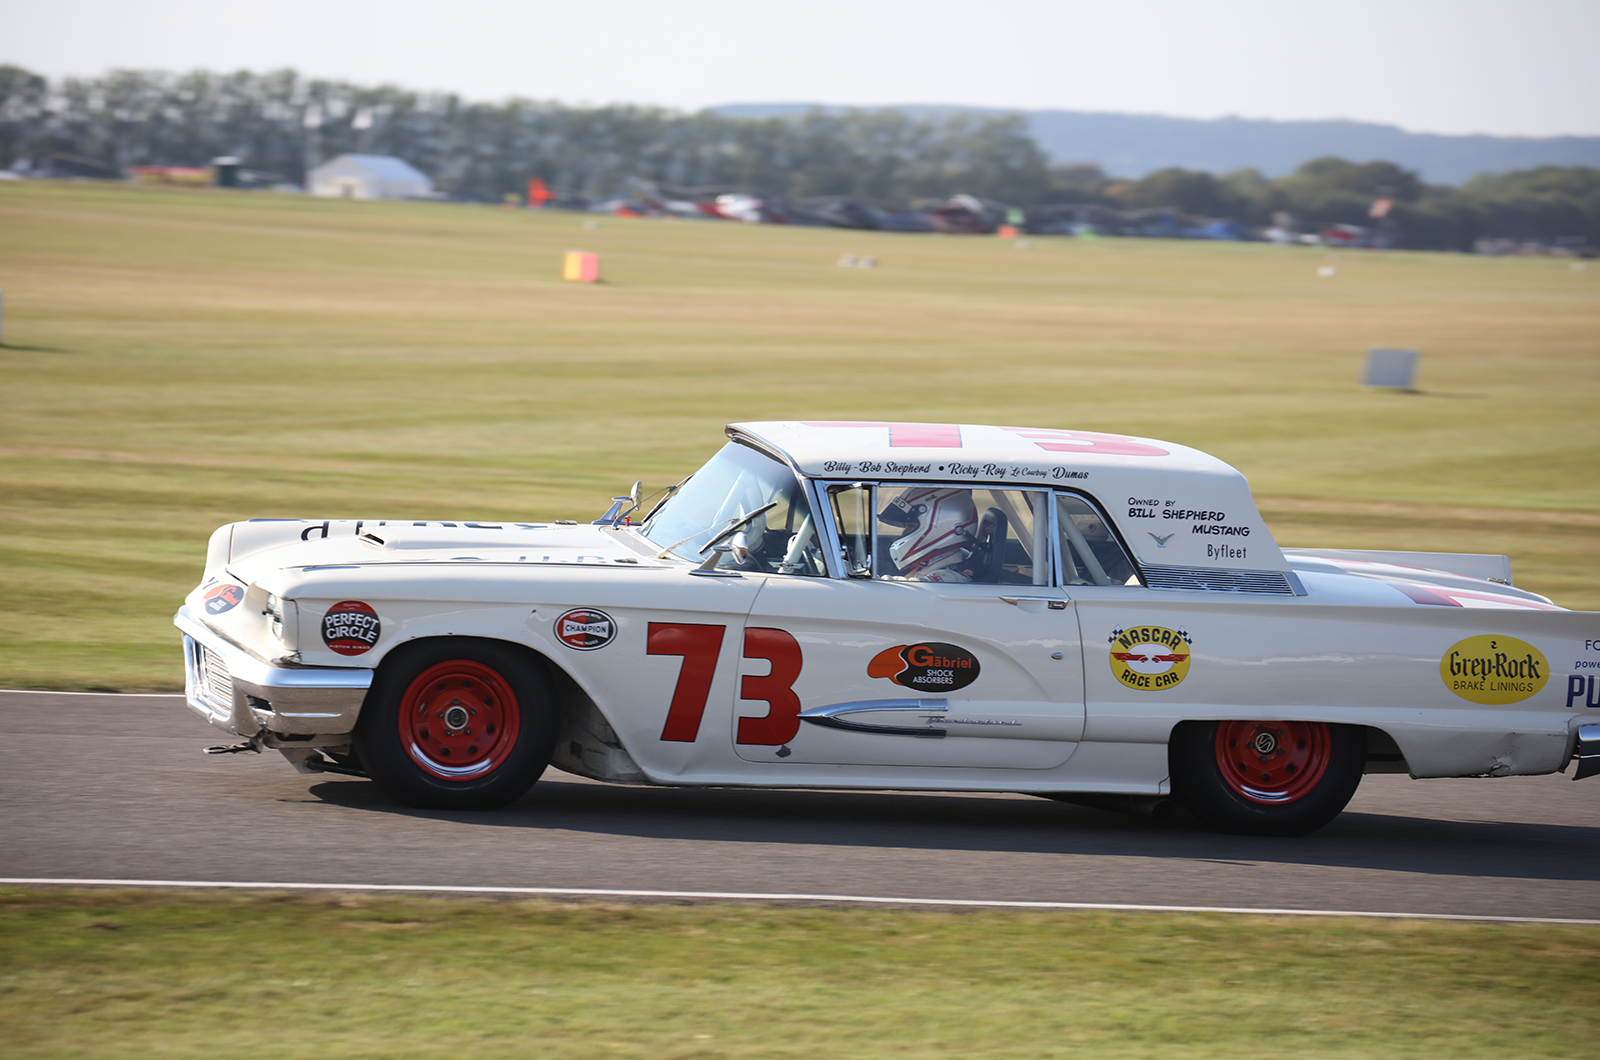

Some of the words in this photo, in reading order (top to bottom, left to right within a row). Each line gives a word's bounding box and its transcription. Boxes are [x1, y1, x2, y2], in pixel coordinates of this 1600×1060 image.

[824, 460, 882, 475] Billy-Bob
[884, 461, 931, 476] Shepherd
[947, 462, 1007, 479] Ricky-Roy
[1052, 466, 1089, 479] Dumas
[1128, 508, 1156, 518] BILL
[1162, 509, 1226, 521] SHEPHERD
[1192, 525, 1251, 537] MUSTANG
[1207, 543, 1247, 560] Byfleet
[325, 612, 379, 630] PERFECT
[565, 624, 607, 634] CHAMPION
[326, 626, 377, 643] CIRCLE
[1118, 628, 1182, 651] NASCAR
[912, 676, 954, 685] ABSORBERS
[926, 669, 954, 677] SHOCK
[1121, 668, 1150, 687] RACE
[1156, 672, 1180, 687] CAR
[646, 621, 803, 746] 73
[1453, 681, 1485, 691] BRAKE
[1490, 683, 1534, 692] LININGS
